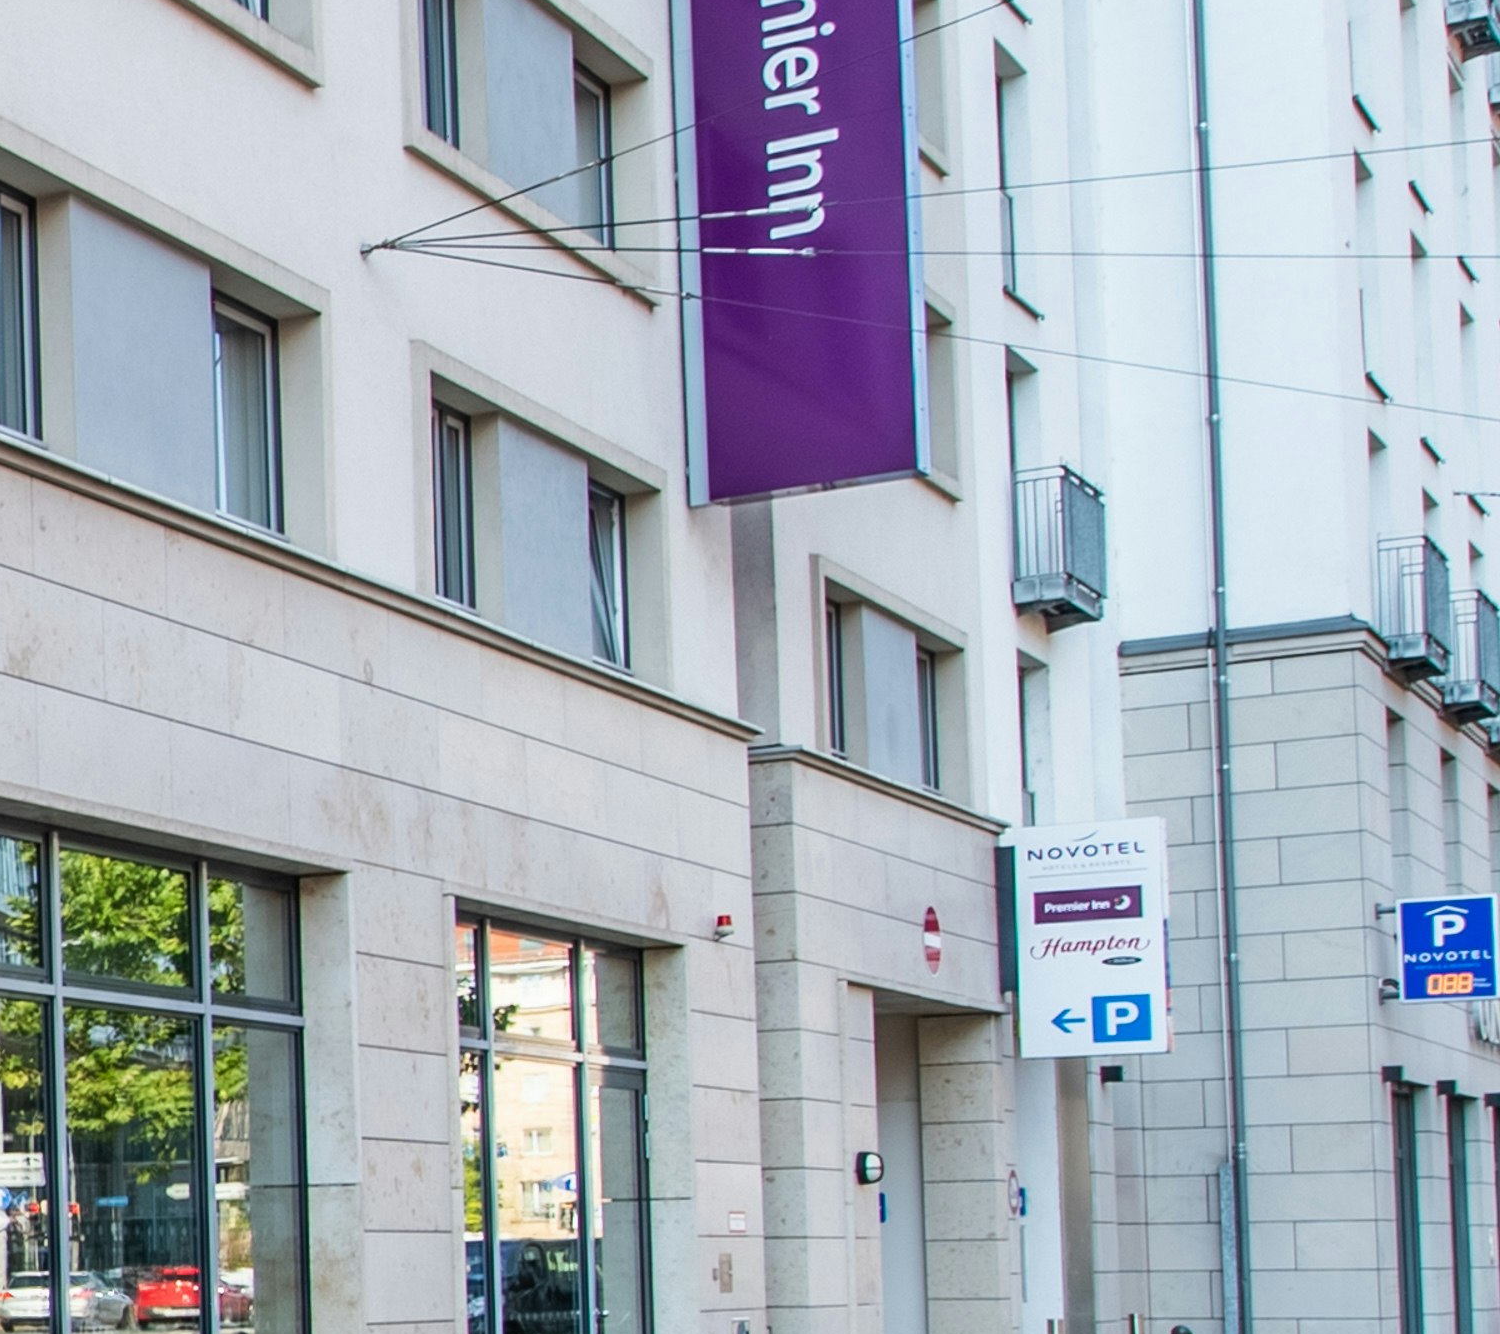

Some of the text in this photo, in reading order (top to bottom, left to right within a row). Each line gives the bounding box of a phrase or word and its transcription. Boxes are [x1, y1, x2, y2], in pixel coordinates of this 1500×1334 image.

[765, 127, 840, 240] Inn
[1027, 842, 1145, 861] NOVOTEL
[1044, 900, 1110, 914] Premier Inn
[1433, 914, 1466, 947] P
[1030, 935, 1151, 960] Hampton
[1404, 950, 1492, 963] NOVOTEL
[1105, 1002, 1139, 1035] P
